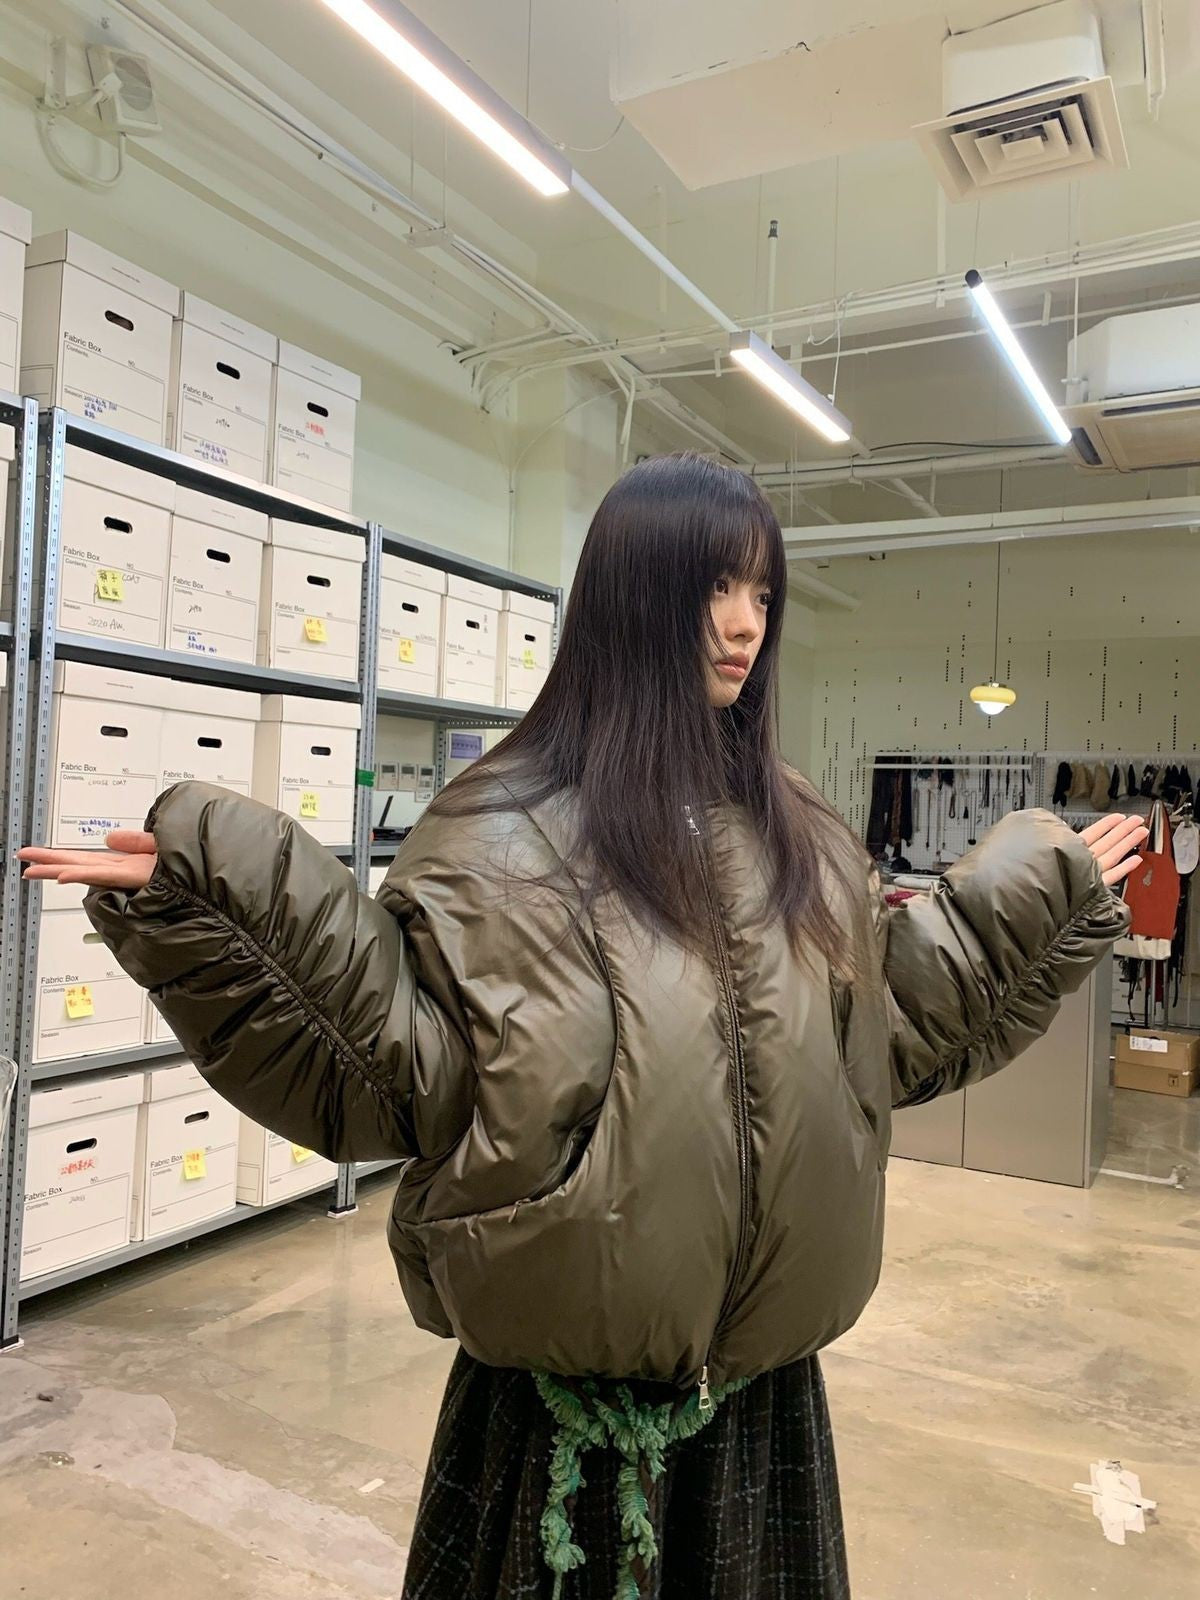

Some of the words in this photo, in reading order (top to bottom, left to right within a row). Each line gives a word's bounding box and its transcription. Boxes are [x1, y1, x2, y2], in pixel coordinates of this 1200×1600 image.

[64, 332, 86, 347] Fabric
[88, 342, 102, 352] Box
[183, 384, 201, 396] Fabric
[202, 391, 214, 400] Box
[279, 424, 294, 434] Fabric
[296, 430, 305, 438] Box
[63, 546, 85, 558] Fabric
[87, 552, 100, 561] Box
[173, 576, 191, 586] Fabric
[192, 581, 204, 589] Box
[276, 602, 293, 610] Fabric
[61, 762, 82, 771] Fabric
[84, 764, 96, 772] Box
[163, 770, 182, 778] Fabric
[282, 776, 298, 784] Fabric
[41, 976, 64, 984] Fabric
[65, 974, 79, 982] Box
[151, 1159, 170, 1168] Fabric
[24, 1191, 47, 1202] Fabric
[48, 1187, 62, 1196] Box
